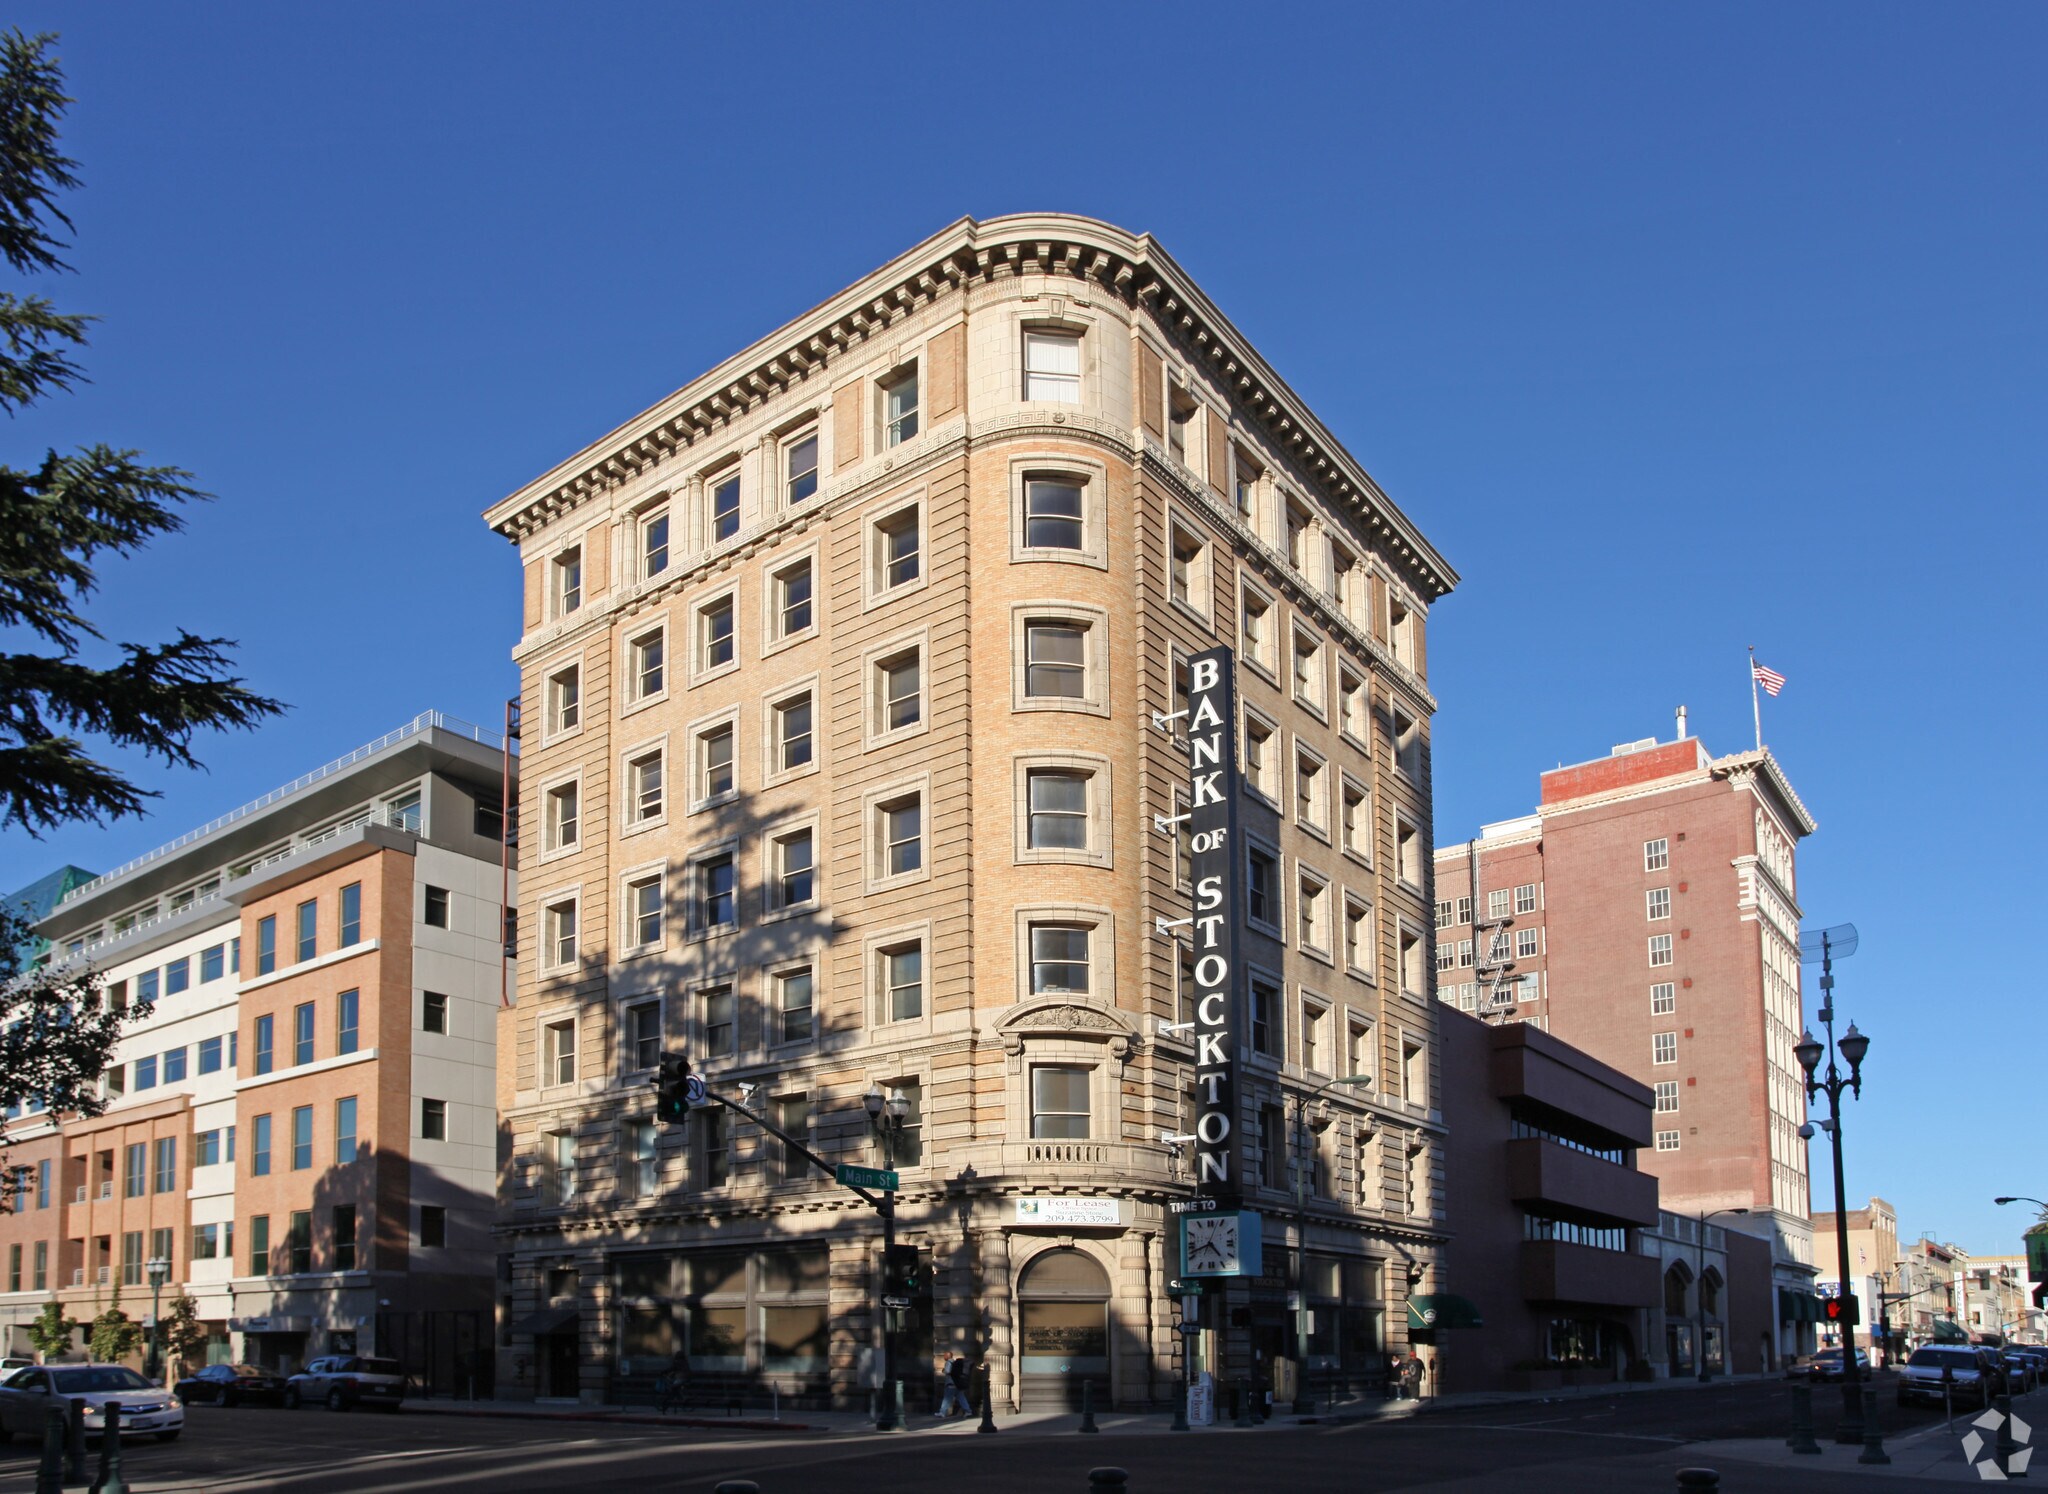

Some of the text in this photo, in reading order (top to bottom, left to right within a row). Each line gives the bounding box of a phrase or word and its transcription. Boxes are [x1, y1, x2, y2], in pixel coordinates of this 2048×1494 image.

[1189, 657, 1232, 1184] BANK OF STOCKTON
[845, 1169, 891, 1187] Main St
[1047, 1199, 1112, 1207] For Lease
[1169, 1200, 1217, 1213] TIME TO
[1045, 1215, 1114, 1223] 209.473.3799
